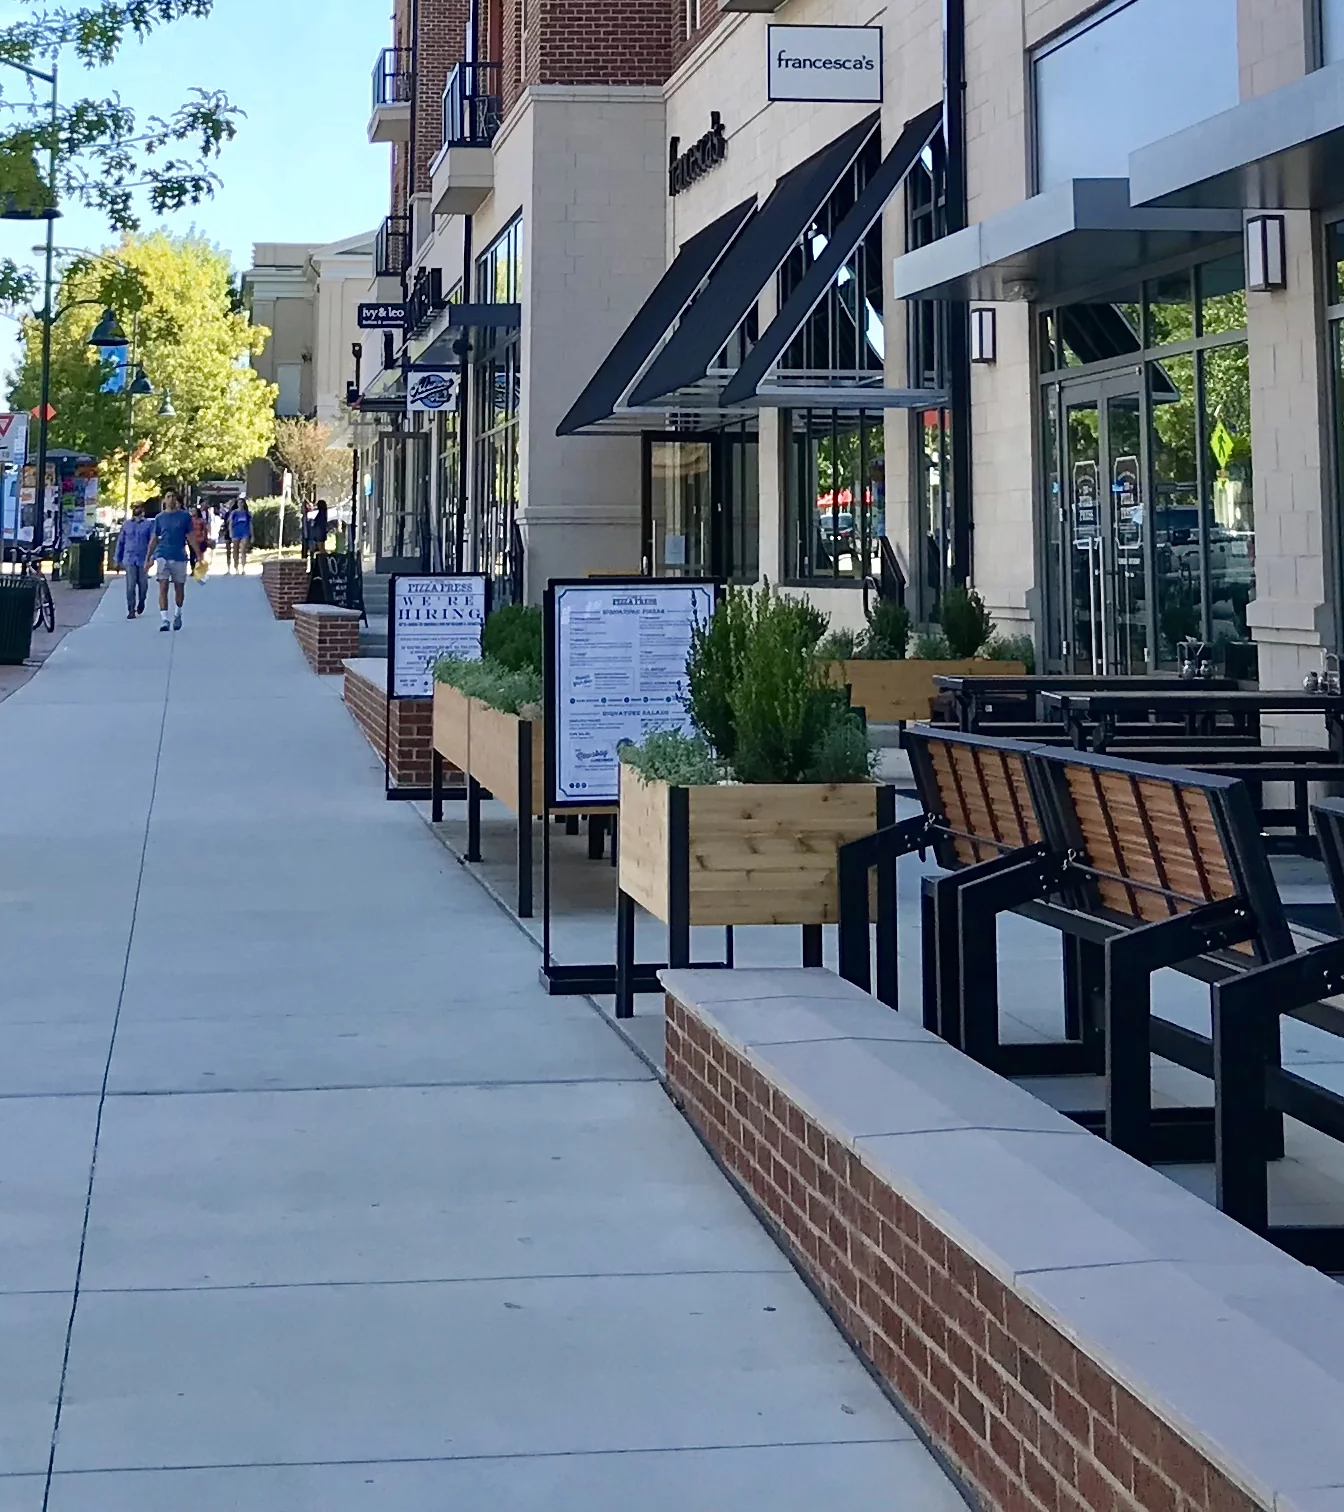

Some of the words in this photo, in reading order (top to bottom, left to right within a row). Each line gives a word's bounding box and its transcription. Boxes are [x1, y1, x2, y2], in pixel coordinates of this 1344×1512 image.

[777, 49, 874, 71] francesca's
[388, 306, 405, 317] leo
[407, 583, 438, 594] PIZZA
[440, 582, 473, 593] PRESS
[403, 596, 474, 607] WE'RE
[398, 608, 481, 620] HIRING
